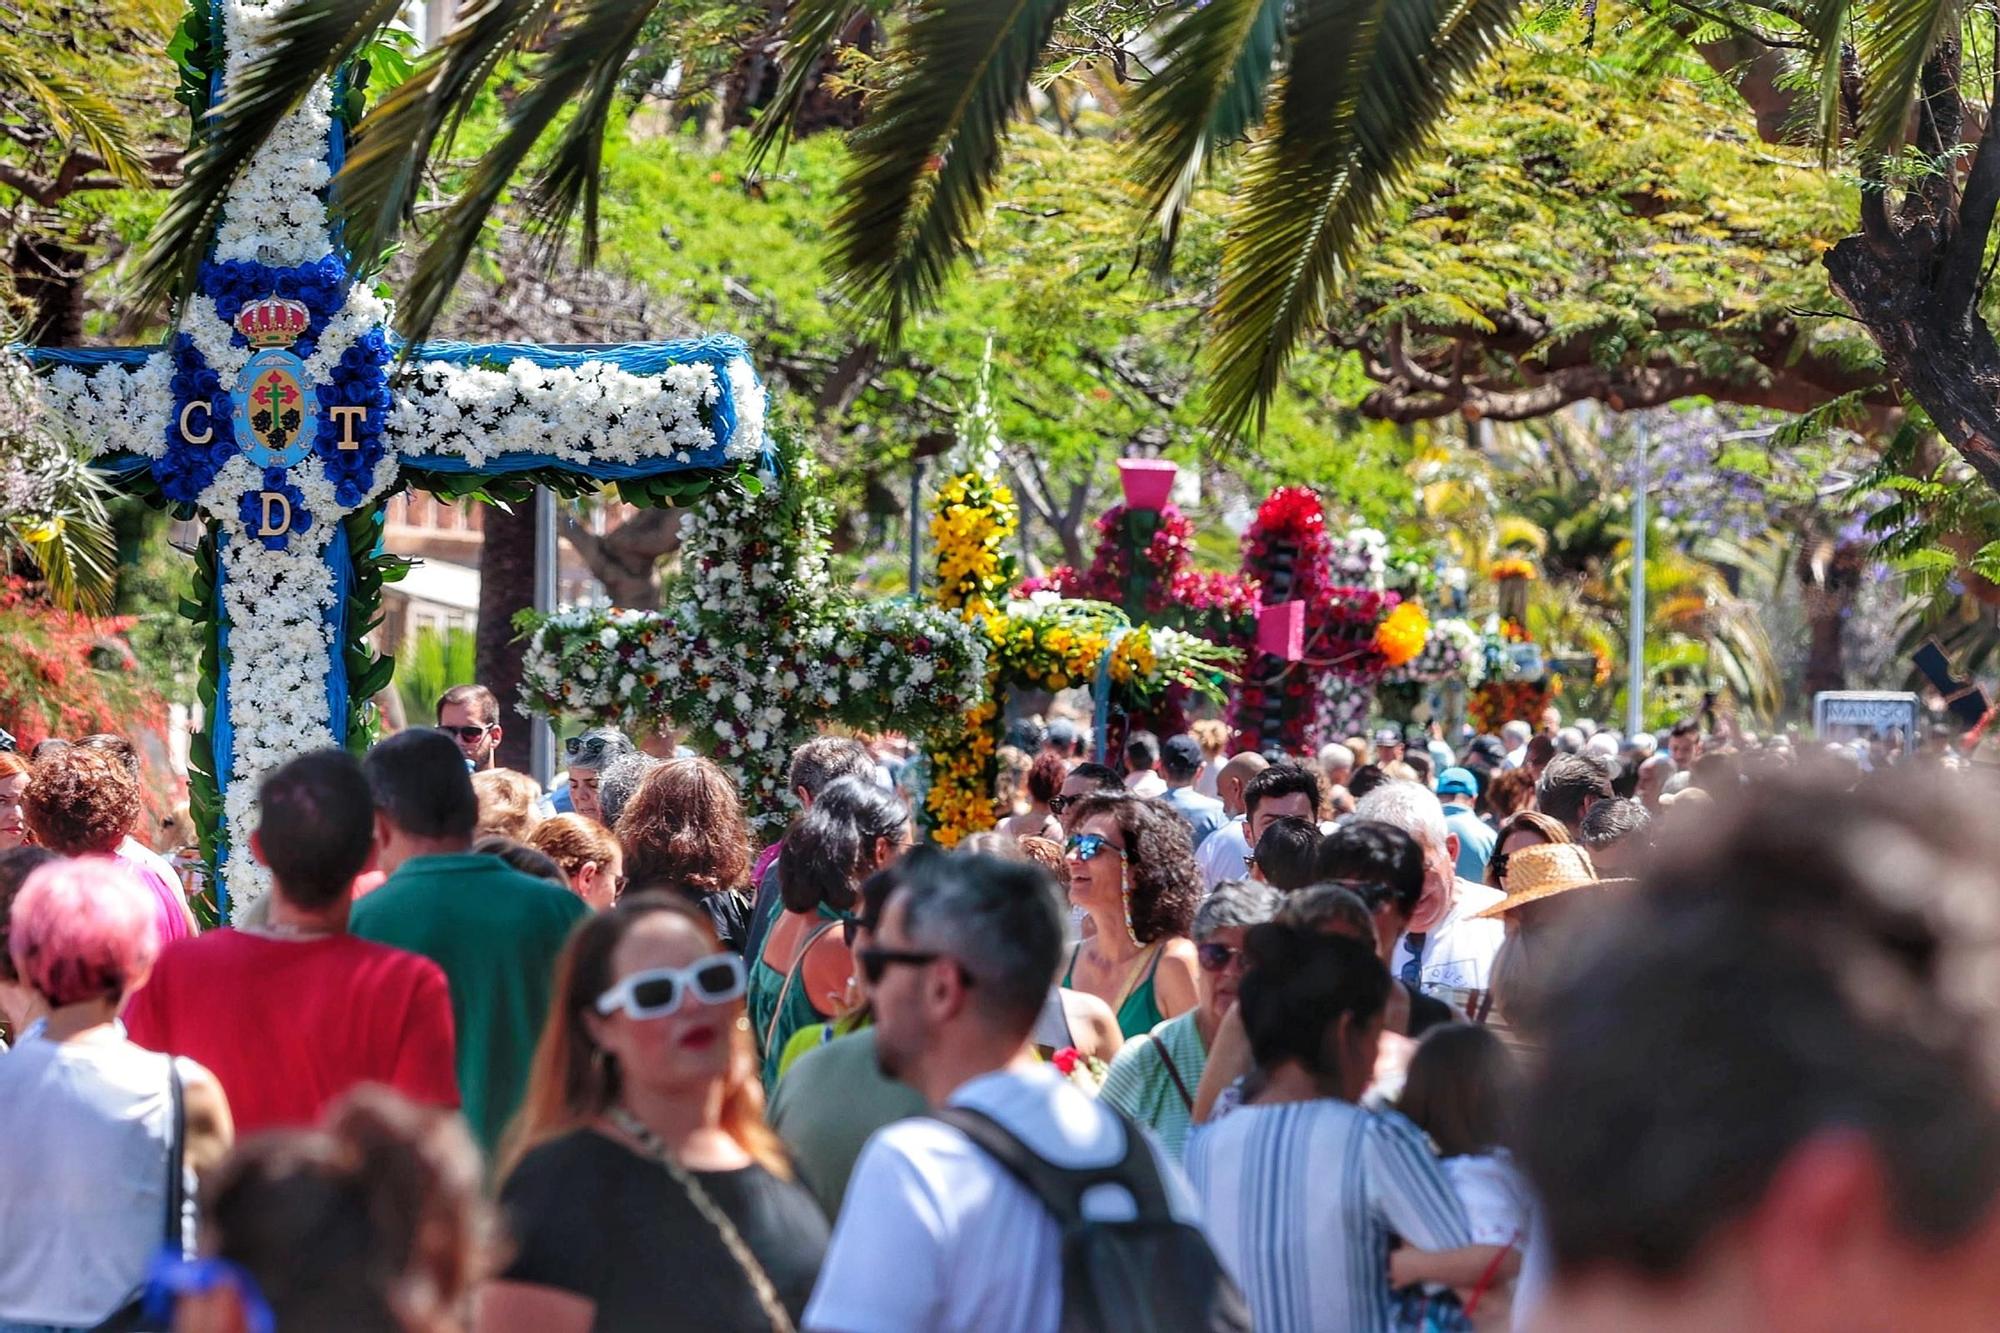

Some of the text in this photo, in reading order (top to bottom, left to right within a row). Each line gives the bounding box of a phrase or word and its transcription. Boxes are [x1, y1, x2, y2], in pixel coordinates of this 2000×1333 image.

[180, 401, 367, 450] C T
[258, 492, 291, 536] D
